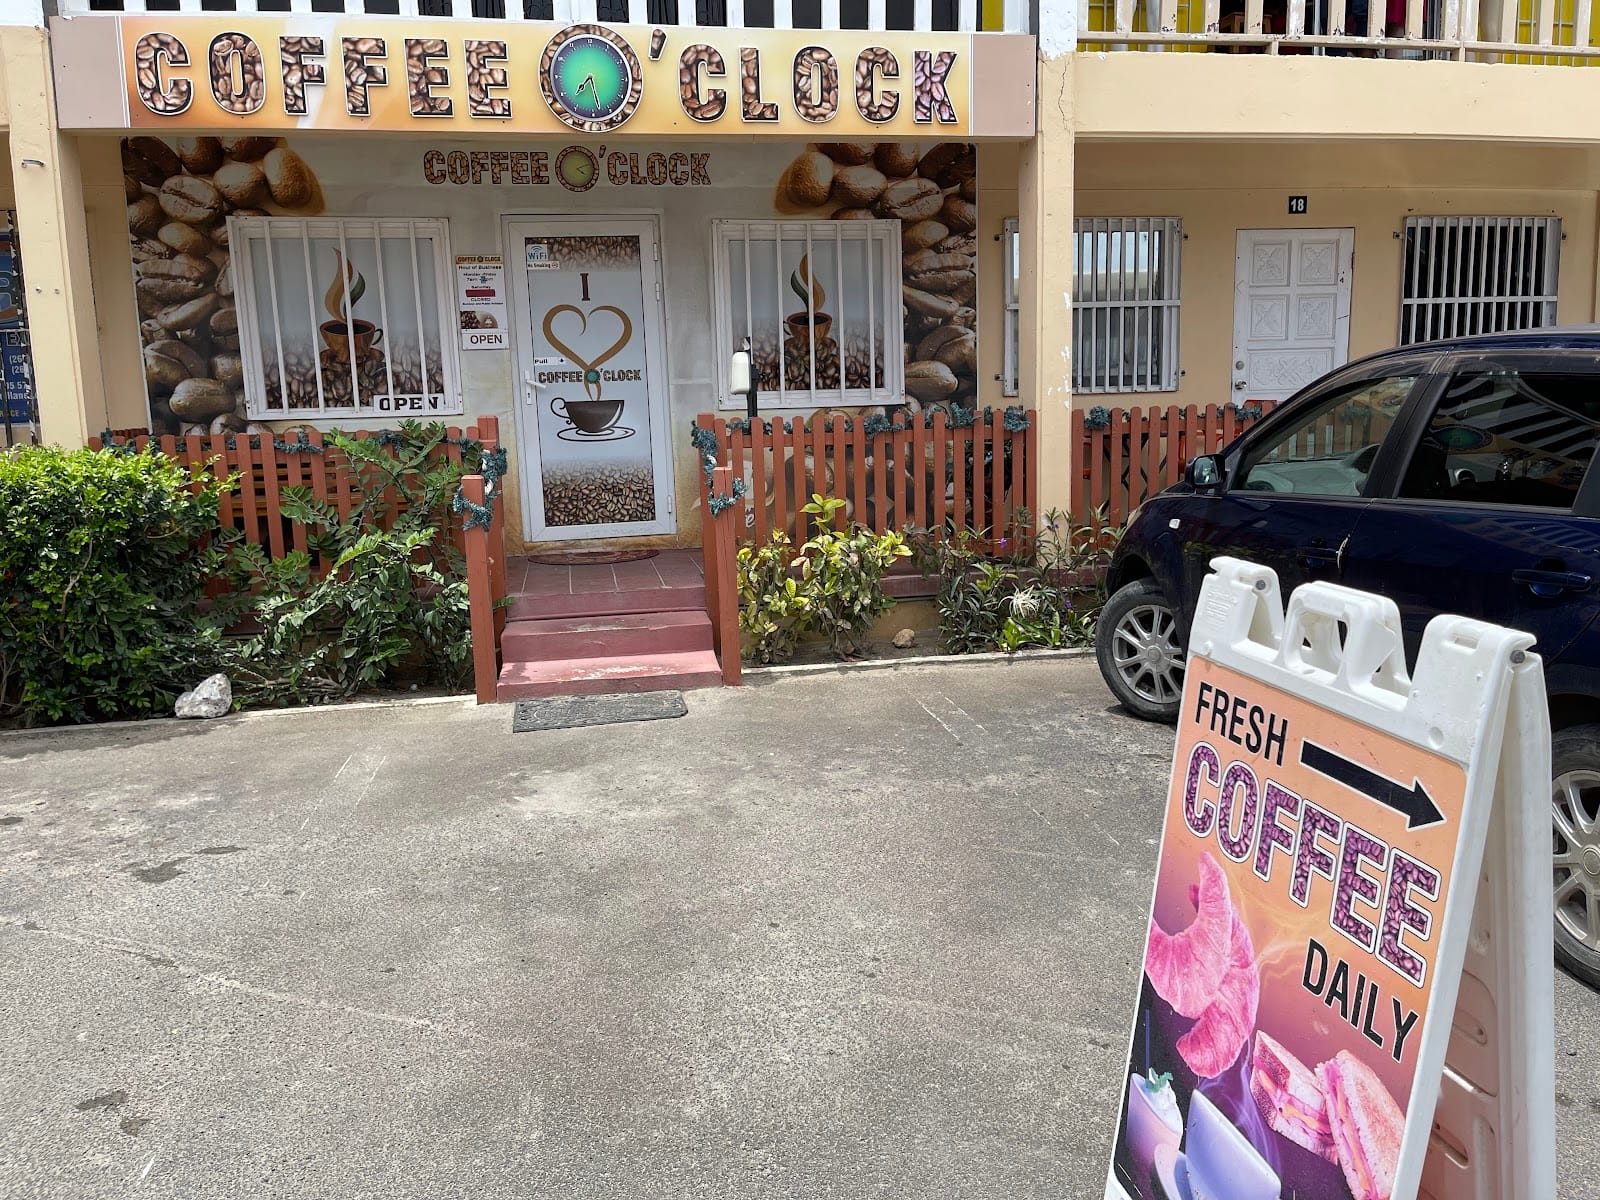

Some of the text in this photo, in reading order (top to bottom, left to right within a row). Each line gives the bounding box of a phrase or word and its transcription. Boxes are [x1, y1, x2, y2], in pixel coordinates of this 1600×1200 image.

[135, 31, 512, 119] COFFEE
[423, 150, 549, 184] COFFEE
[1290, 198, 1305, 212] 18
[580, 272, 591, 301] I
[470, 334, 502, 344] OPEN
[538, 371, 583, 384] COFFEE
[379, 396, 439, 411] OPEN
[1195, 681, 1288, 767] FRESH
[1182, 741, 1442, 989] COFFEE
[1302, 938, 1420, 1063] DAILY
